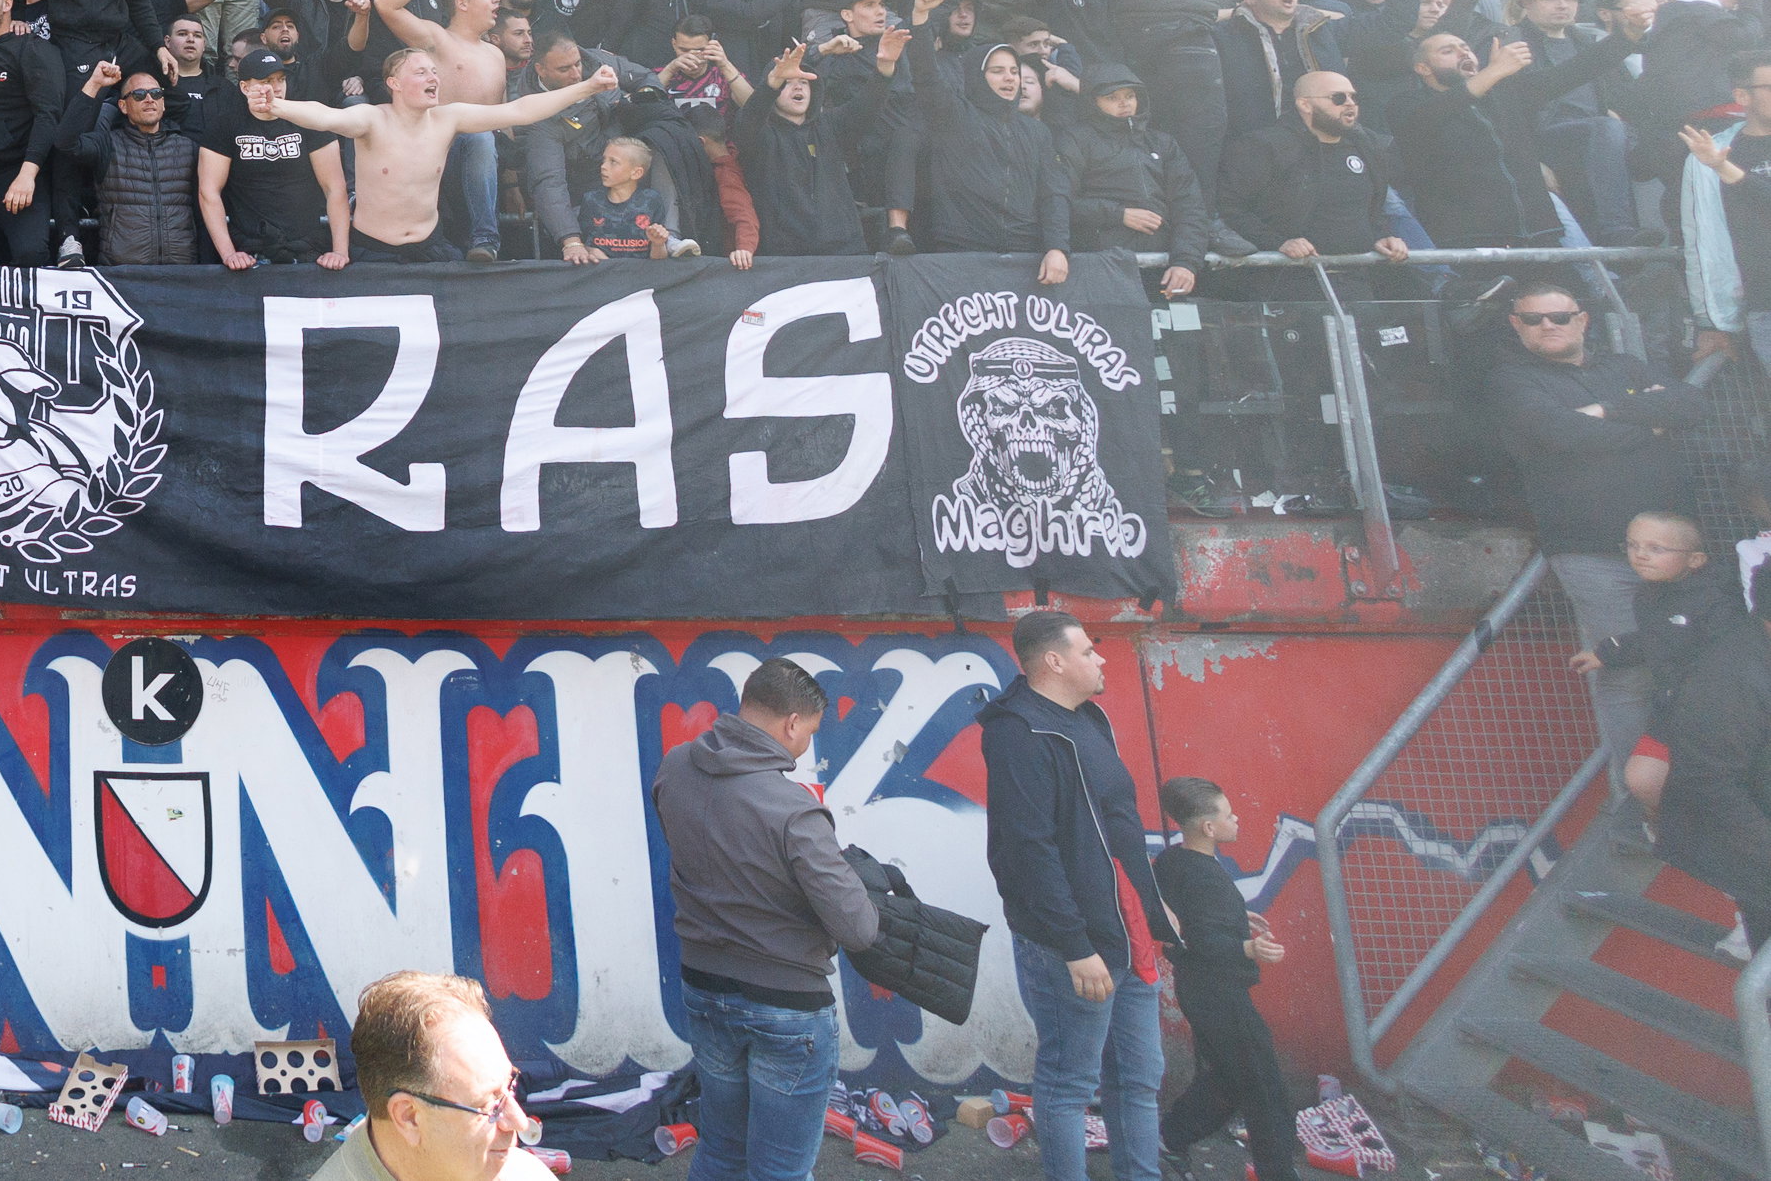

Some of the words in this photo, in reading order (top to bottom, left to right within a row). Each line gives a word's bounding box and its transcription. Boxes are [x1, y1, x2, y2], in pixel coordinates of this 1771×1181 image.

[242, 143, 264, 156] 20
[279, 142, 299, 156] 19
[277, 135, 300, 144] ULTRAS
[594, 237, 649, 247] CONCLUSION
[54, 290, 93, 311] 19
[903, 291, 1018, 384] UTRECHT
[1026, 295, 1142, 391] ULTRAS
[263, 276, 894, 532] RAS
[24, 567, 138, 598] ULTRAS
